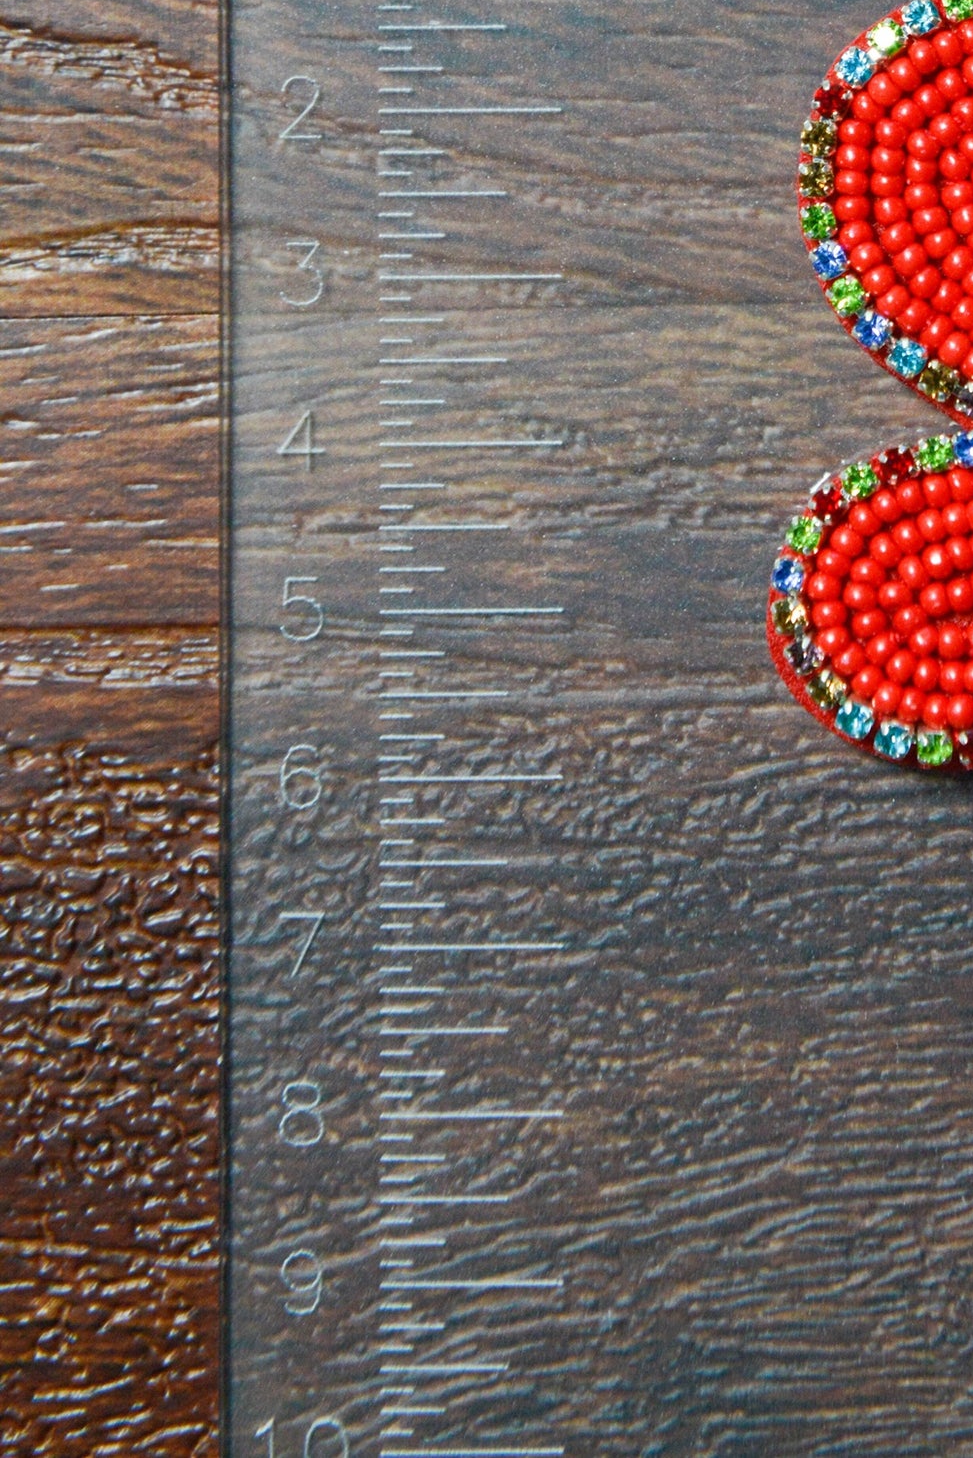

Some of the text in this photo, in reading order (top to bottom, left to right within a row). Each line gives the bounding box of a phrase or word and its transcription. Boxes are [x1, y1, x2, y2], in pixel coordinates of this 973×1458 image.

[279, 75, 322, 138] 2
[279, 241, 323, 305] 3
[276, 409, 326, 472] 4
[279, 576, 324, 641] 5
[280, 743, 322, 810] 6
[279, 911, 325, 978] 7
[279, 1081, 324, 1146] 8
[280, 1248, 323, 1316] 9
